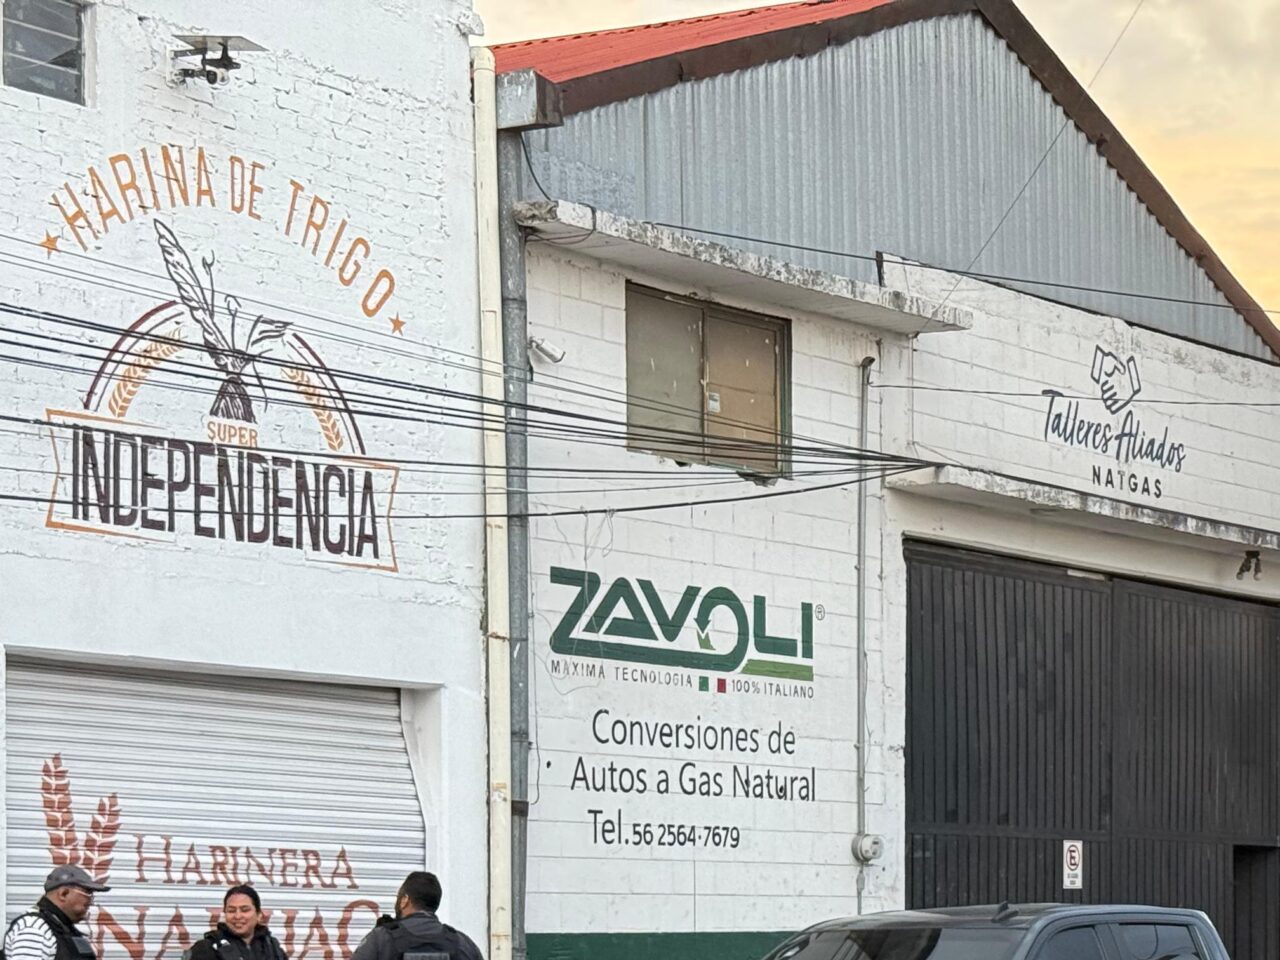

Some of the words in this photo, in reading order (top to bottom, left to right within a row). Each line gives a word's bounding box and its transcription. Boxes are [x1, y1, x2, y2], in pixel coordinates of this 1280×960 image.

[50, 143, 216, 252] HARINA
[229, 154, 266, 222] DE
[284, 179, 397, 318] TRIGO
[206, 420, 259, 449] SUPER
[1041, 389, 1114, 454] Talleres
[1114, 409, 1187, 473] Aliados
[71, 423, 380, 560] INDEPENDENCIA
[1092, 464, 1163, 499] NATGAS
[549, 566, 814, 673] ZAVOLI
[551, 659, 605, 680] MAXIMA
[614, 666, 693, 689] TECNOLOGIA
[731, 679, 761, 695] 100%
[763, 682, 814, 699] ITALIANO
[592, 709, 760, 753] Conversiones
[767, 721, 796, 755] de
[570, 756, 647, 794] Autos
[656, 773, 669, 795] a
[678, 761, 723, 797] Gas
[732, 765, 816, 802] Natural
[133, 834, 360, 890] HARINERA
